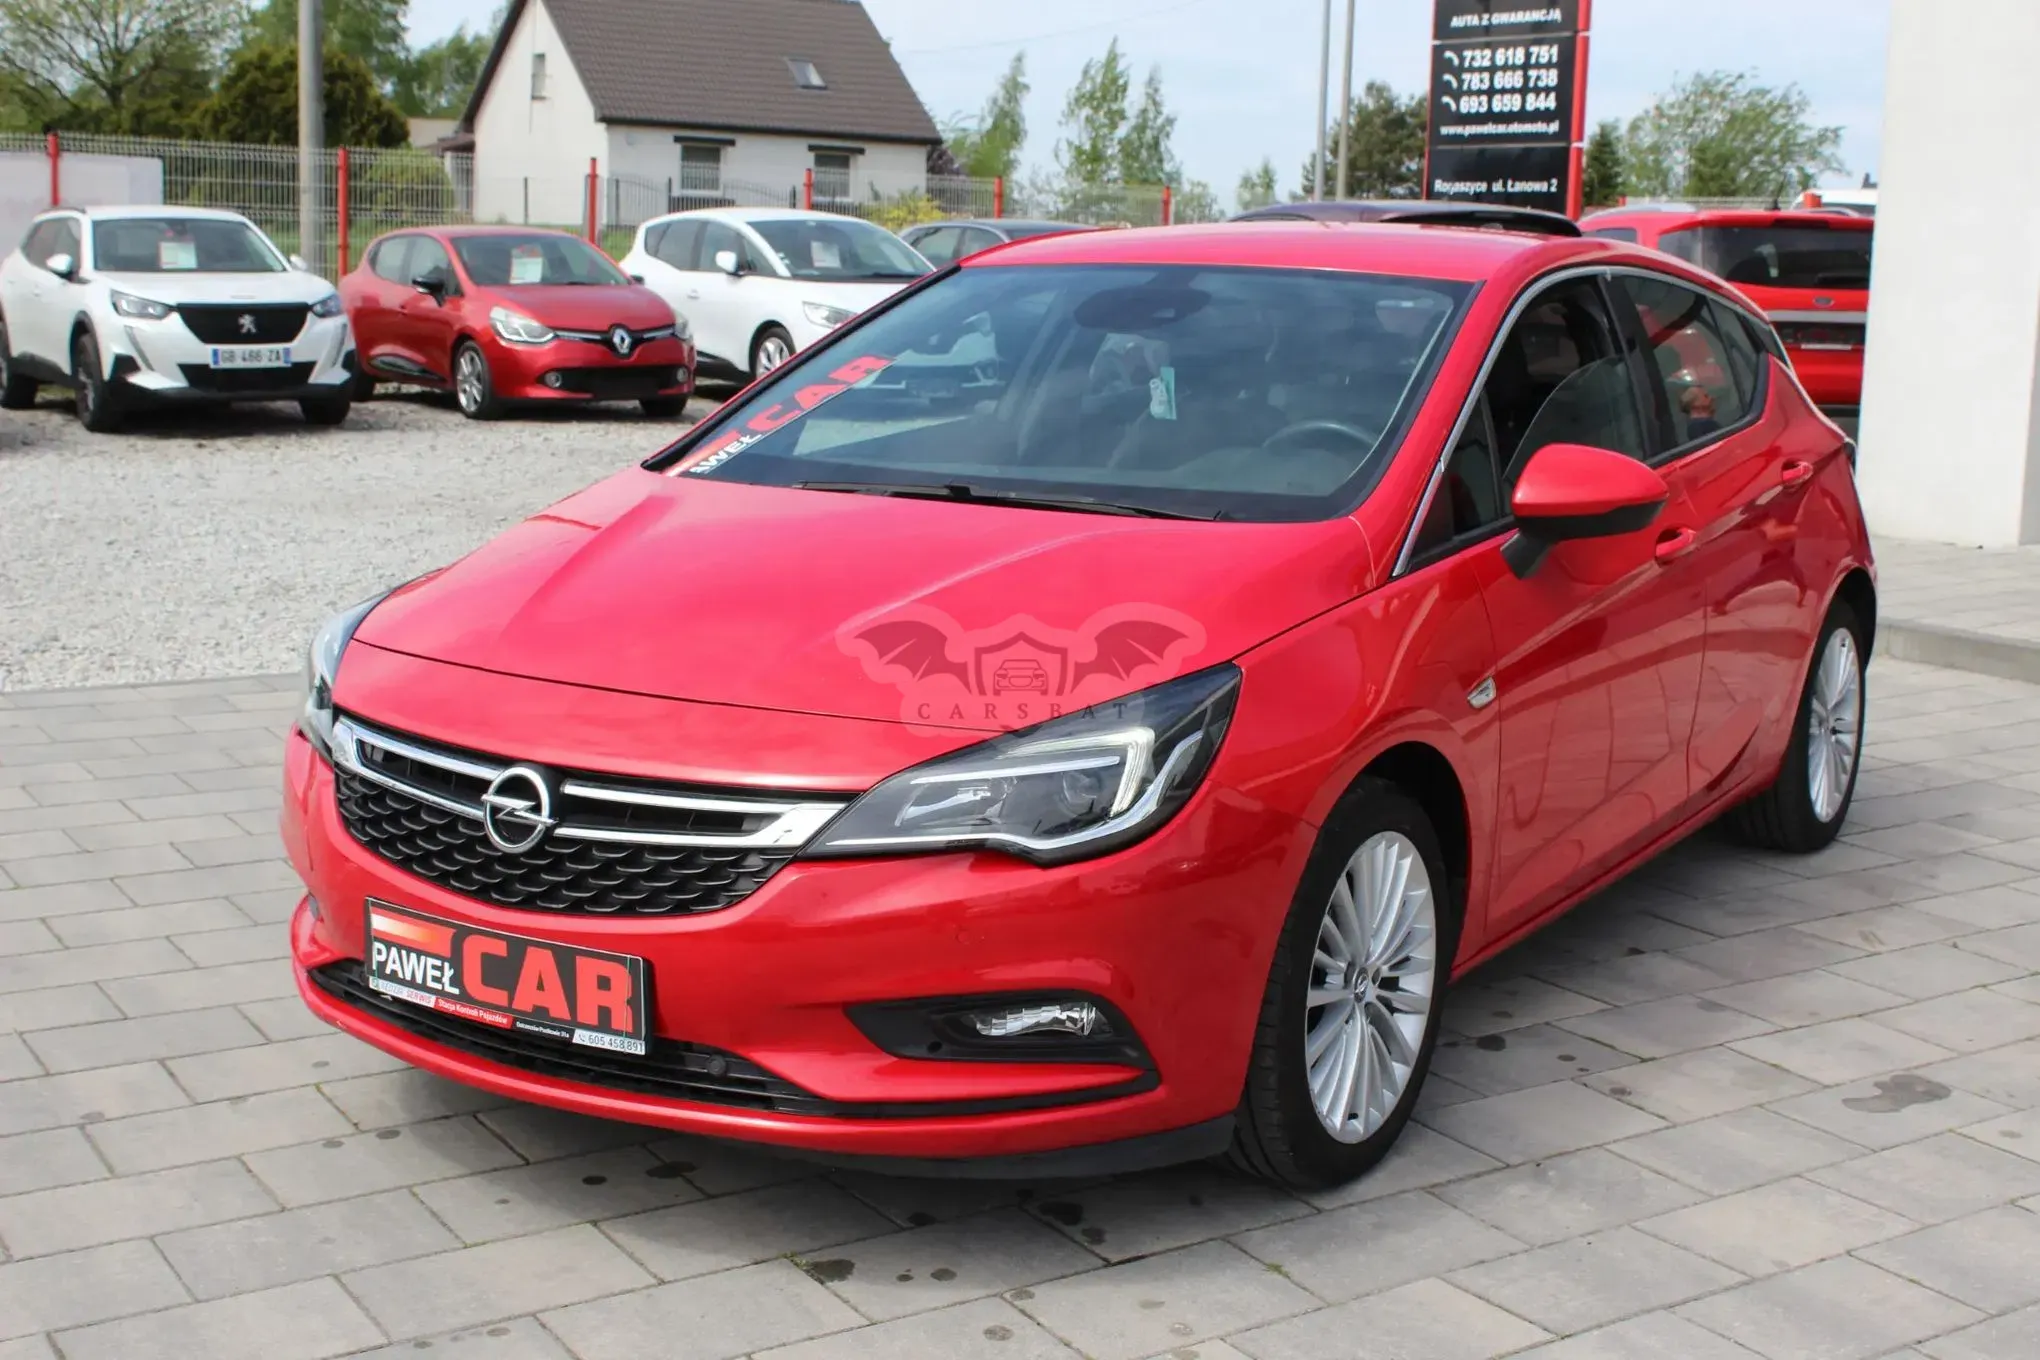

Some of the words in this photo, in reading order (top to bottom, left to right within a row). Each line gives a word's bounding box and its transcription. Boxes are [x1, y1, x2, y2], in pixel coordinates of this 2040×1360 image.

[1450, 15, 1480, 28] AUTA
[1481, 13, 1490, 26] Z
[1462, 48, 1492, 68] 732
[1495, 46, 1525, 66] 618
[1529, 44, 1559, 64] 751
[1461, 71, 1491, 91] 783
[1493, 69, 1524, 89] 666
[1527, 68, 1558, 88] 738
[1459, 94, 1488, 114] 693
[1492, 93, 1522, 113] 659
[1525, 91, 1557, 111] 844
[1491, 178, 1505, 192] ul.
[1549, 178, 1558, 192] 2
[689, 433, 763, 474] AWEŁ
[746, 355, 892, 432] CAR
[372, 942, 460, 995] PAWEŁ
[462, 934, 633, 1033] CAR
[588, 1034, 606, 1046] 605
[607, 1037, 625, 1049] 458
[626, 1040, 643, 1053] 891
